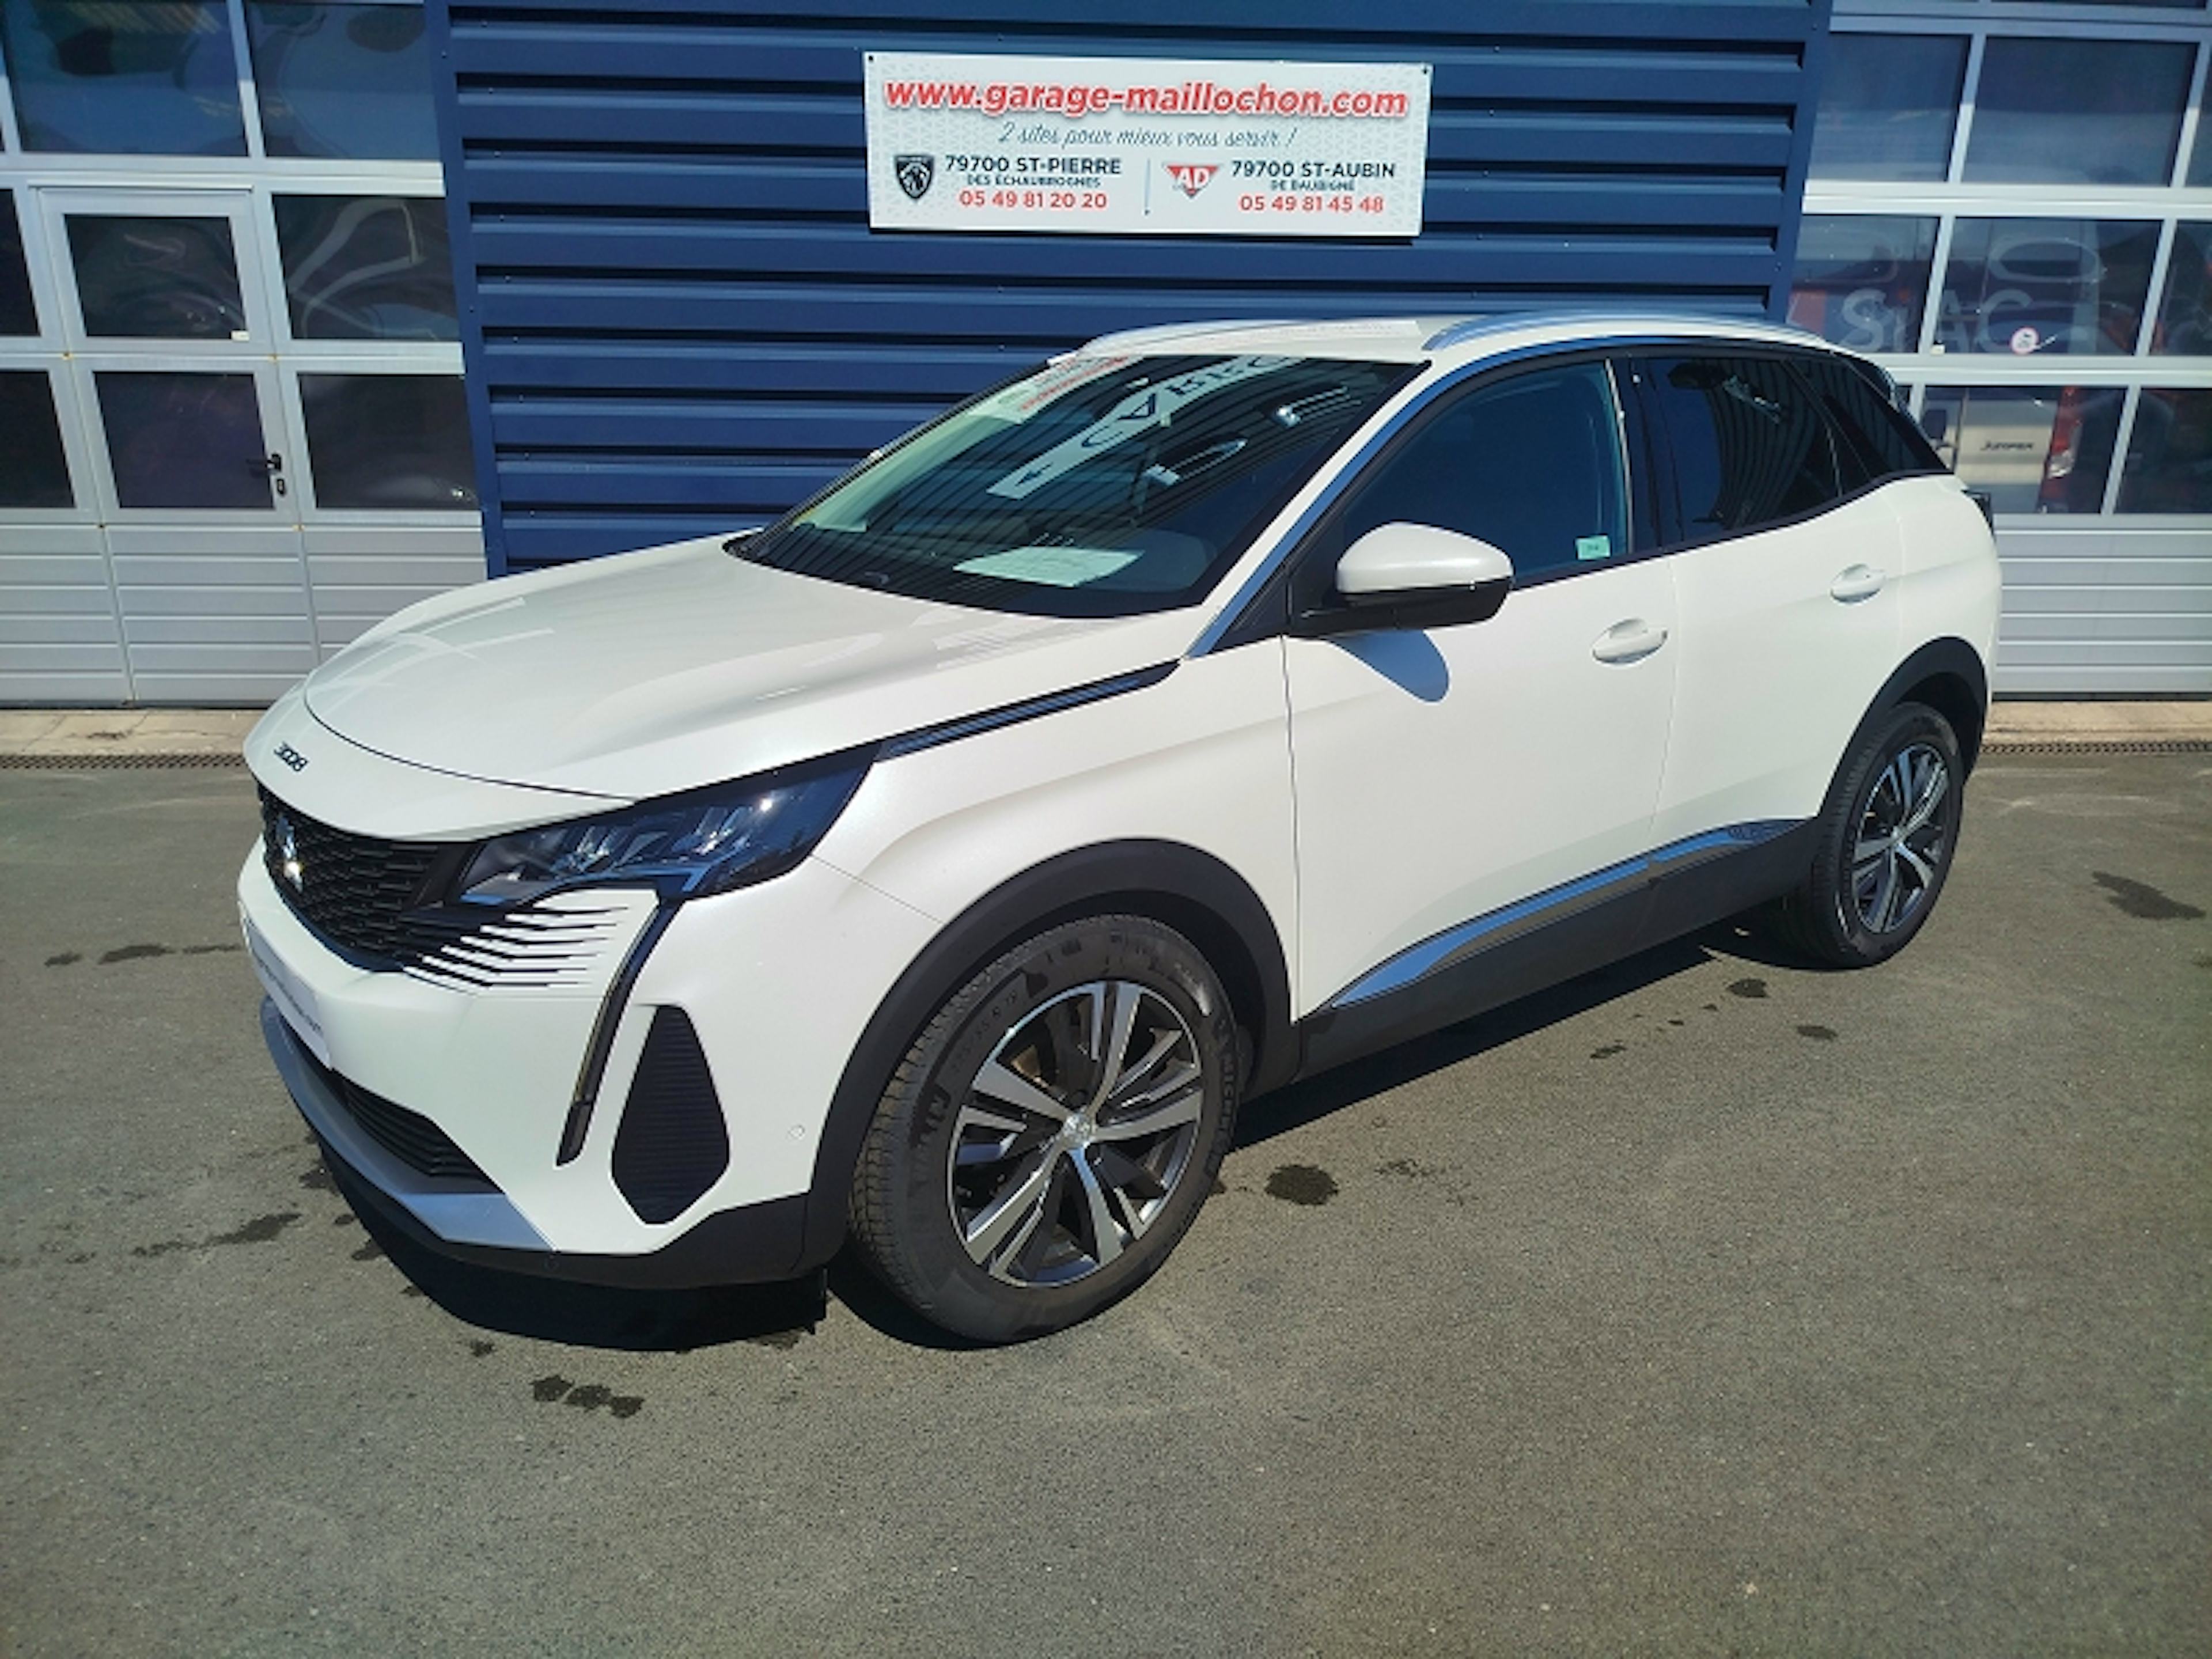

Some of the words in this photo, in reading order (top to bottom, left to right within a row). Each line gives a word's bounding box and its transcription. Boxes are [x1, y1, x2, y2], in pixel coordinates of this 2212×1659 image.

[886, 82, 1408, 117] www.garage-maillochon.com
[998, 122, 1016, 143] 2
[1017, 124, 1058, 145] sites
[1062, 128, 1112, 149] pour
[1116, 127, 1172, 146] mieux
[1177, 132, 1219, 147] vous
[945, 155, 1009, 172] 79700
[1016, 157, 1122, 175] ST-PIERRE
[1232, 160, 1294, 177] 79700
[1301, 161, 1396, 179] ST-AUBIN
[960, 191, 985, 207] 05
[992, 192, 1018, 208] 49
[1023, 192, 1043, 208] 81
[1051, 193, 1075, 209] 20
[1082, 194, 1107, 209] 20
[1239, 195, 1265, 210] 05
[1272, 196, 1296, 211] 49
[1302, 196, 1322, 211] 81
[1328, 196, 1353, 211] 45
[1360, 197, 1384, 212] 48
[273, 741, 309, 772] 3008
